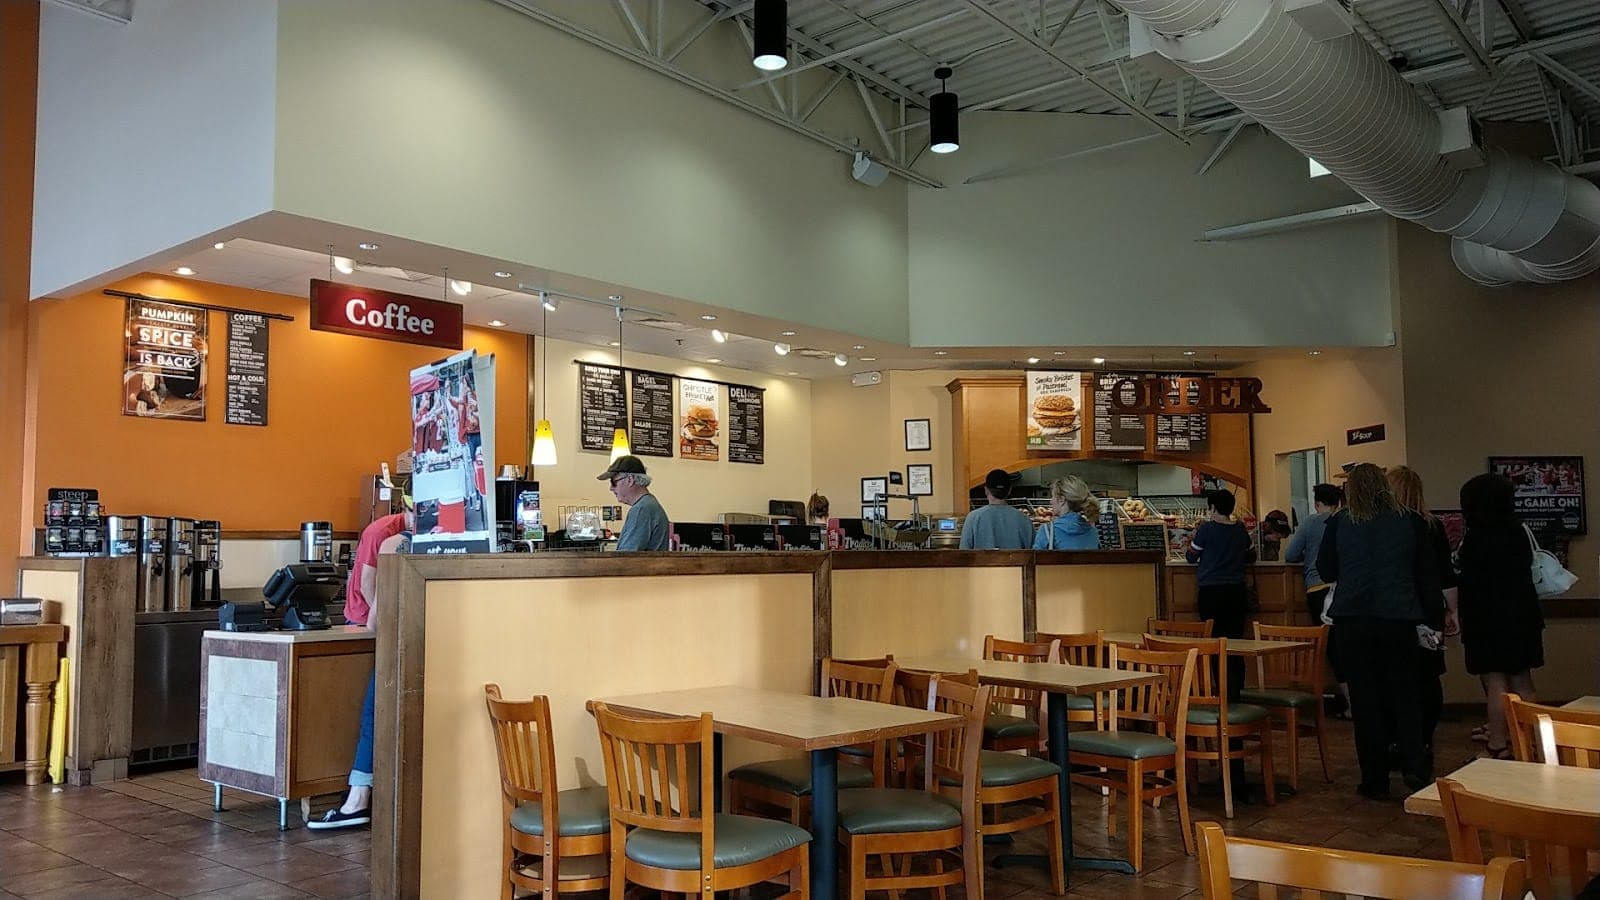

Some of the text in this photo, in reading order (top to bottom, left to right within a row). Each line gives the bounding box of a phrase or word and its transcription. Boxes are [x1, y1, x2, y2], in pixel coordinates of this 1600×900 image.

[141, 307, 194, 322] PUMPKIN
[234, 314, 263, 323] COFFEE
[345, 299, 434, 335] Coffee
[139, 328, 193, 347] SPICE
[140, 354, 192, 368] IS BACK
[637, 376, 656, 385] BAGEL
[730, 388, 747, 398] DELI
[1112, 376, 1271, 412] ORDER
[57, 490, 89, 501] steep
[1524, 498, 1555, 508] GAME
[1558, 498, 1580, 507] ON!
